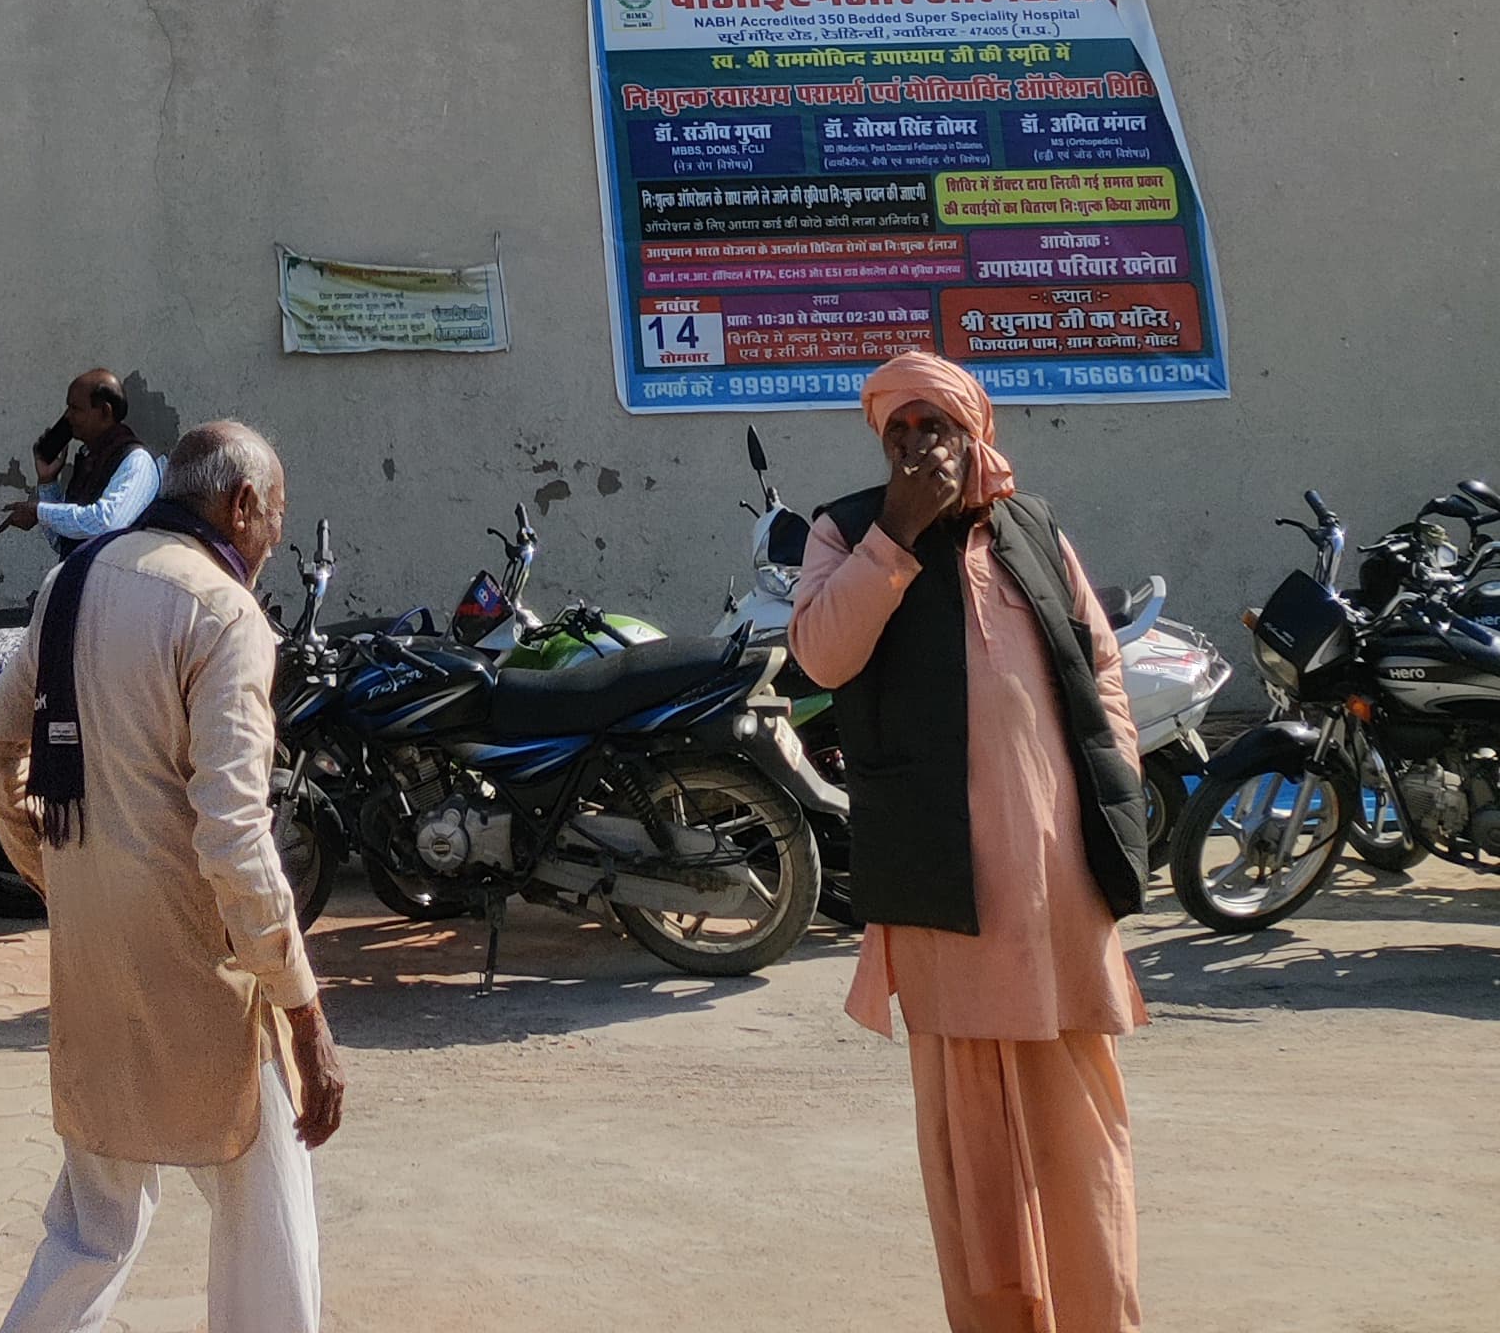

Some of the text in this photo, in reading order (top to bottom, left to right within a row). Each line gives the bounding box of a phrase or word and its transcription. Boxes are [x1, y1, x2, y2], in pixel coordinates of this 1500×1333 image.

[694, 9, 1080, 28] NABH Accredited 350 Bedded Super Speciality Hospital
[717, 25, 1009, 45] सूर्य मंदिर रोड, ग्वालियर 474005
[710, 42, 1073, 70] स्व. श्री रामगोविन्द उपाध्याय जी की स्मृति में
[795, 77, 866, 106] परामर्श
[868, 76, 902, 104] एवं
[903, 73, 1011, 103] मोतियाबिंद
[1014, 72, 1103, 101] ऑपरेशन
[1103, 71, 1156, 99] शिवि
[823, 115, 978, 139] डॉ. सौरभ सिंह तोमर
[1020, 111, 1148, 134] डॉ. अमित मंगल
[654, 121, 772, 145] डॉ. संजीव गुप्ता
[1066, 136, 1123, 147] (Orthopedics)
[671, 144, 740, 156] MBBS, DOMS,
[1097, 148, 1112, 159] रोग
[697, 159, 713, 172] रोग
[946, 176, 978, 193] शिविर
[980, 175, 991, 191] में
[1084, 173, 1100, 190] गई
[1103, 175, 1134, 189] समस्त
[1137, 174, 1164, 188] प्रकार
[677, 187, 713, 208] ऑपरेशन
[714, 186, 723, 206] के
[724, 190, 741, 206] साथ
[743, 186, 760, 205] लाने
[761, 185, 771, 205] ले
[771, 184, 789, 204] जाने
[790, 184, 802, 204] की
[803, 184, 829, 209] सुविधा
[886, 183, 899, 202] की
[943, 195, 1171, 215] की का वितरण किया जायेगा
[645, 213, 929, 233] ऑपरेशन के लिए आधार की फोटो कॉपी लाना है
[695, 245, 719, 257] भारत
[722, 243, 756, 256] योजना
[757, 242, 768, 255] के
[846, 239, 867, 253] रोगों
[869, 241, 882, 252] का
[1040, 231, 1101, 249] आयोजक
[753, 267, 842, 280] TPA, ECHS ESI
[977, 252, 1178, 279] उपाध्याय परिवार खनेता
[654, 297, 700, 312] नवंबर
[812, 295, 840, 306] समय
[1051, 290, 1092, 304] स्थान
[757, 308, 930, 326] 10:30 से दोपहर 02:30 बजे तक
[960, 305, 1170, 337] श्री रघुनाथ जी का मंदिर
[648, 316, 699, 349] 14
[727, 331, 769, 345] शिविर
[896, 329, 932, 343] शुगर
[969, 336, 1030, 352] विजयराम
[1067, 335, 1093, 349] ग्राम
[1144, 332, 1179, 347] गोहद
[660, 352, 709, 364] सोमवार
[643, 364, 1211, 399] सम्पर्क करें 999943798 7566610304
[1474, 616, 1500, 625] Her
